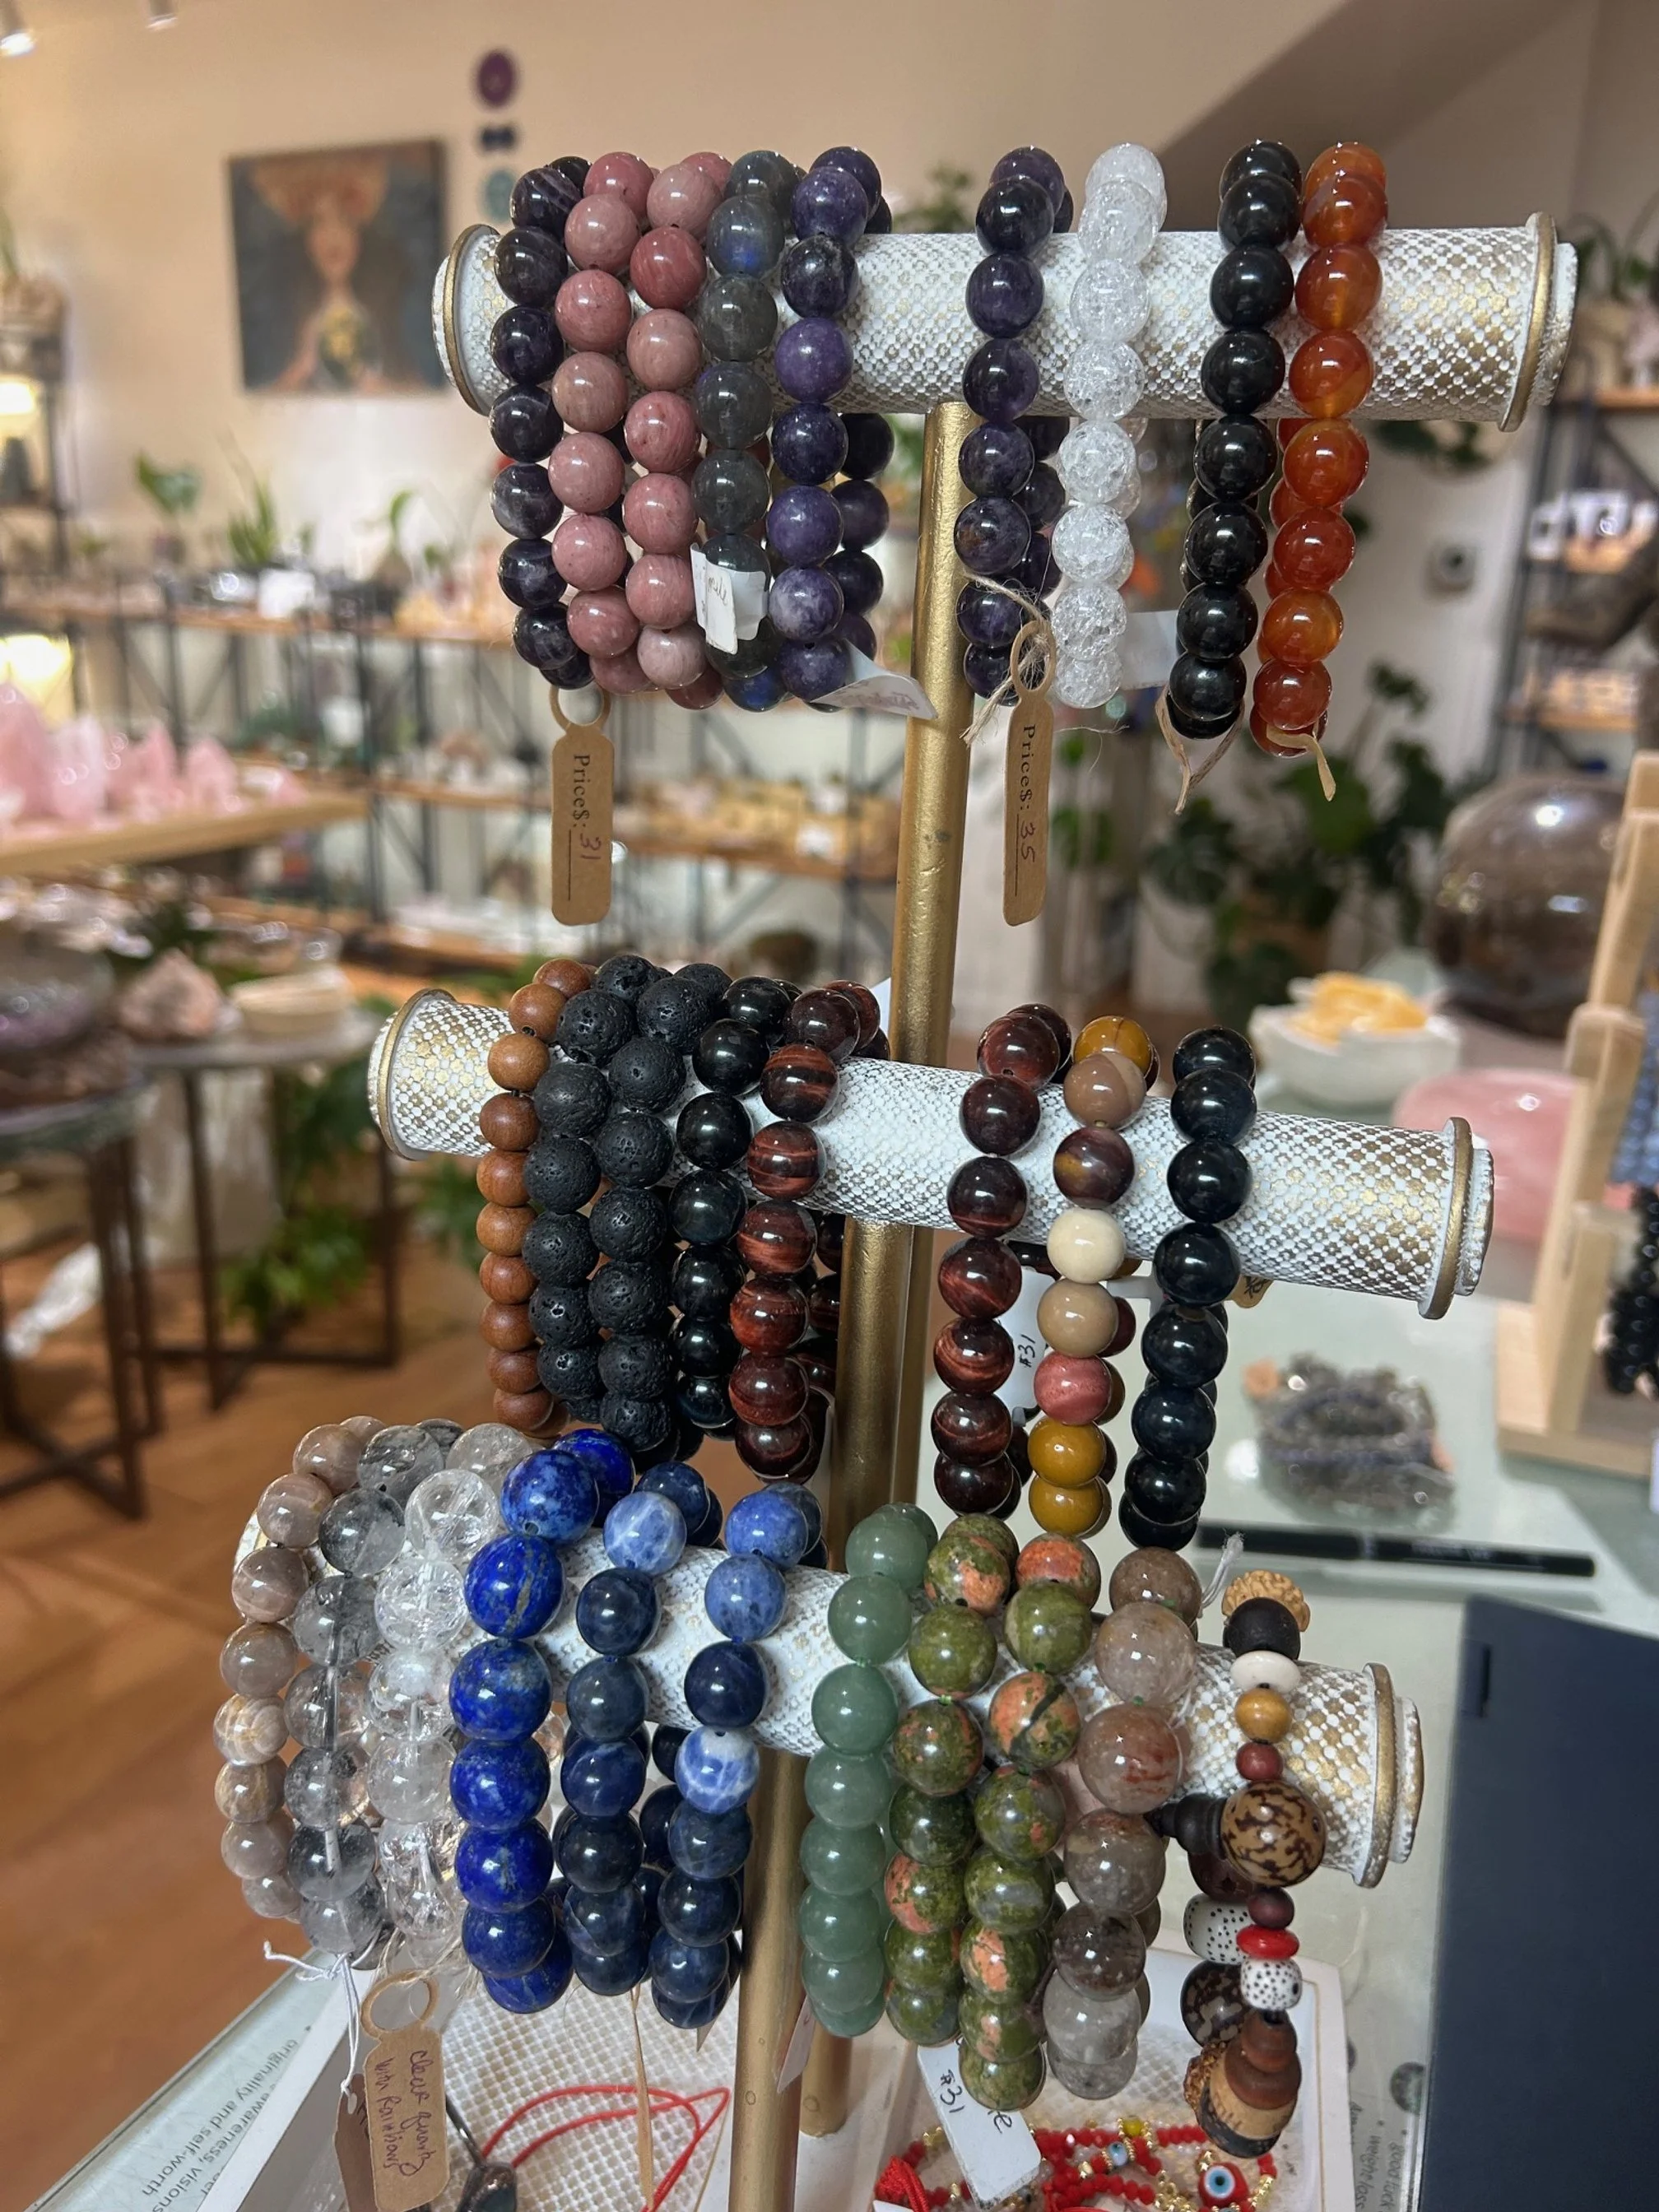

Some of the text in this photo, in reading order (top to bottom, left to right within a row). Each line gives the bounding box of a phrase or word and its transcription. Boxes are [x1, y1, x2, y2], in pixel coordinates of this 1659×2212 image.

[579, 832, 602, 861] 31
[1020, 820, 1036, 863] 35
[237, 2039, 299, 2102] originality
[210, 2099, 237, 2130] and
[142, 2128, 212, 2197] self-worth
